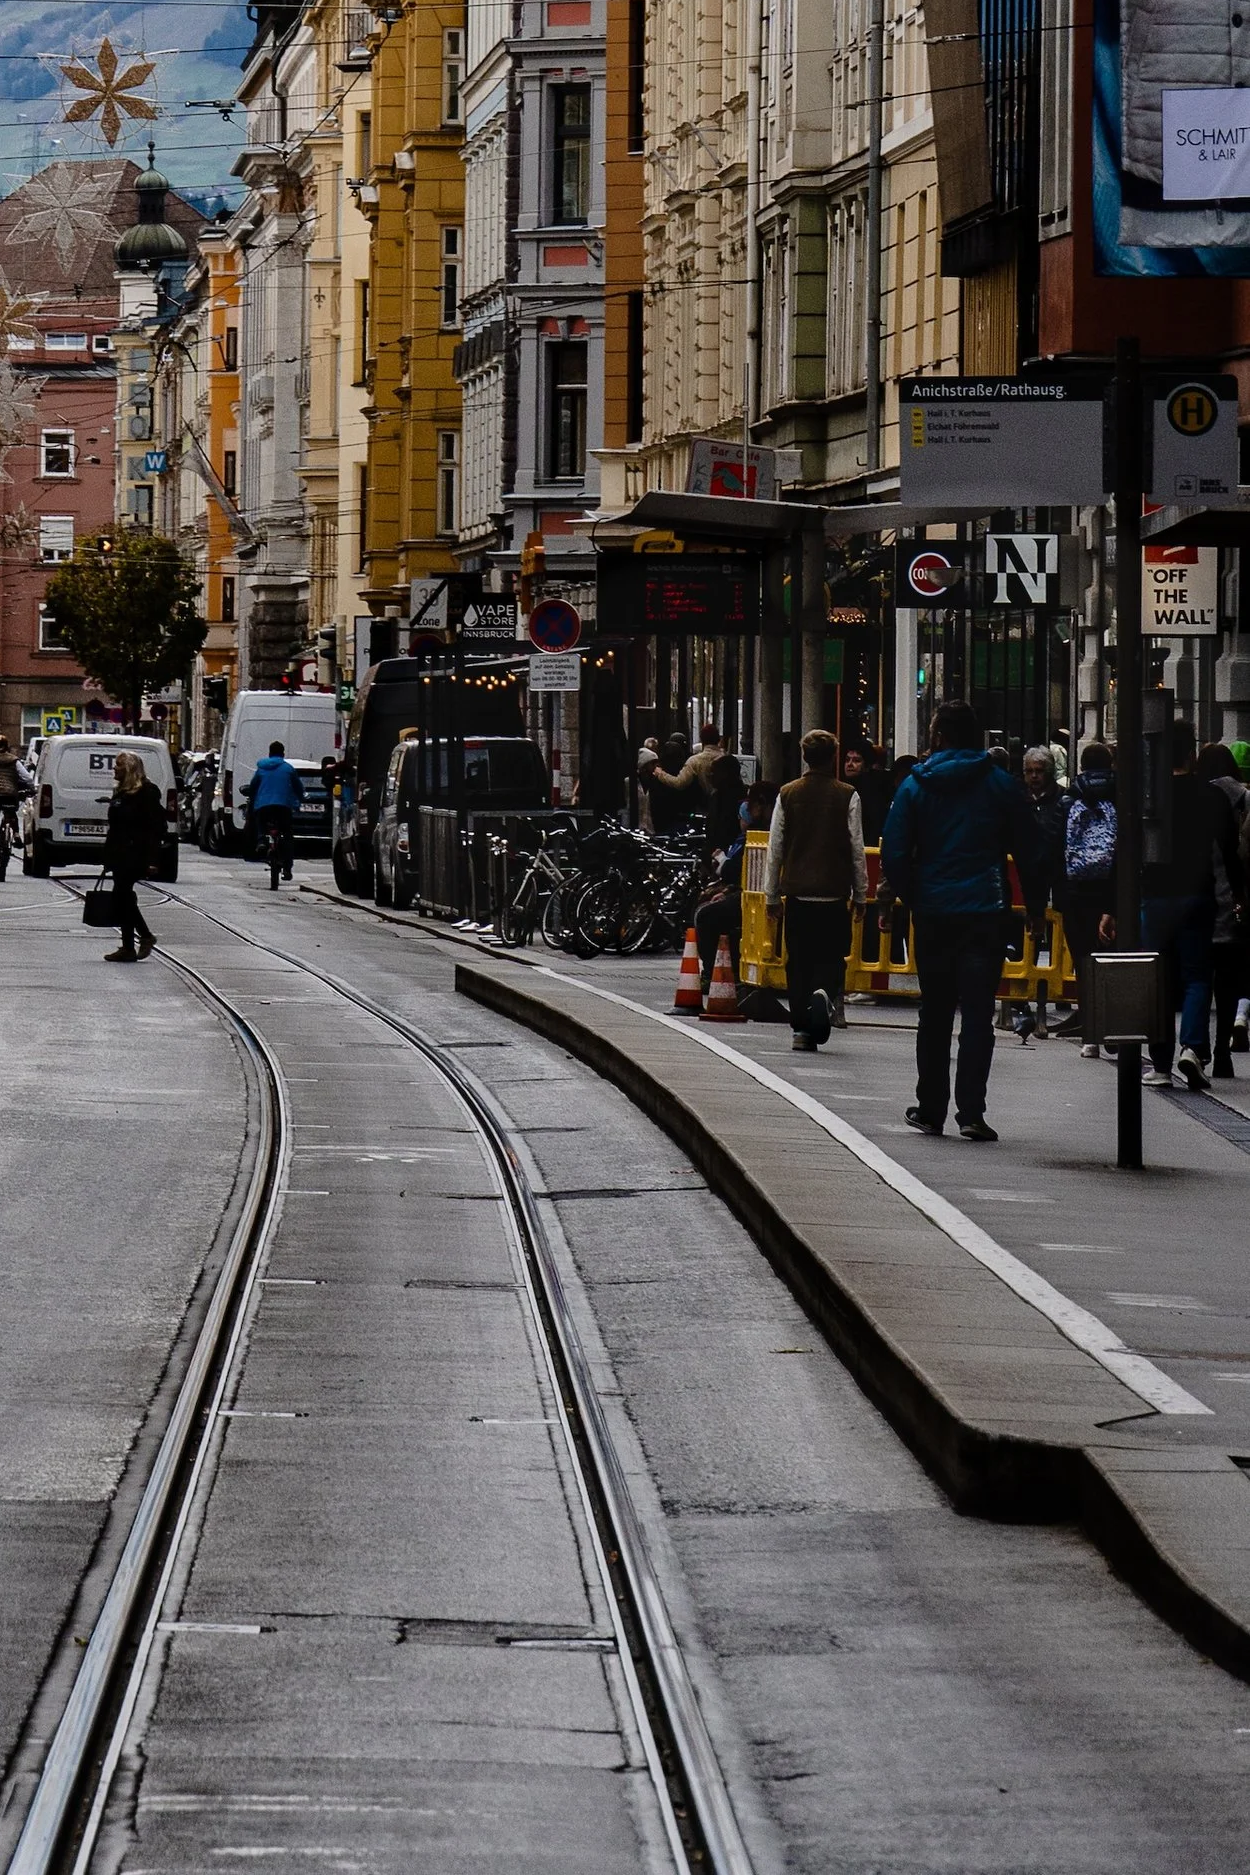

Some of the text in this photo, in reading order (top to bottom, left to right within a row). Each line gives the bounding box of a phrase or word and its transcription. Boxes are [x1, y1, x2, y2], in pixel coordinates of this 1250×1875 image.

[1176, 127, 1250, 146] SCHMIT
[1198, 148, 1236, 161] & LAIR
[911, 383, 1068, 399] Anichstraße/Rathausg.
[1181, 397, 1204, 425] H
[711, 446, 760, 461] Bar Cfé
[146, 455, 165, 469] W
[1153, 589, 1188, 604] THE
[476, 604, 515, 616] VAPE
[480, 616, 515, 625] STORE
[463, 630, 515, 639] INNSBRUCK
